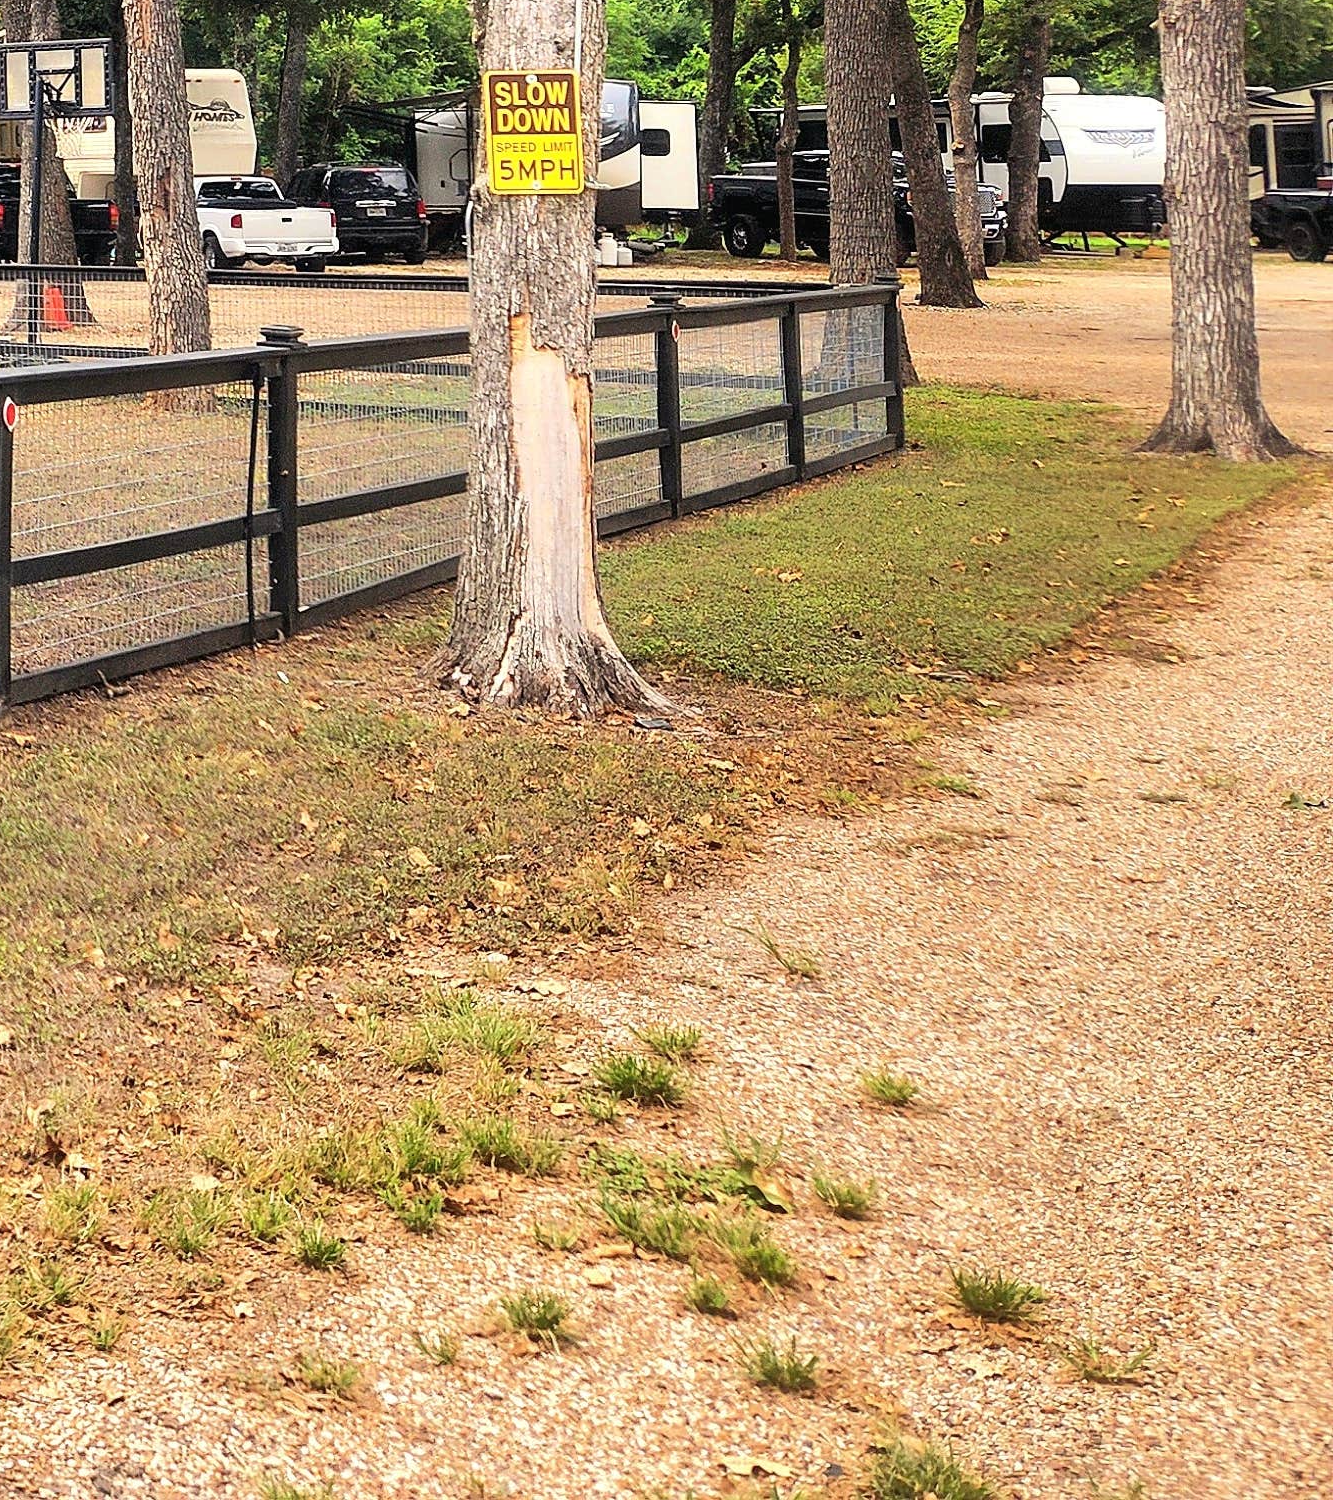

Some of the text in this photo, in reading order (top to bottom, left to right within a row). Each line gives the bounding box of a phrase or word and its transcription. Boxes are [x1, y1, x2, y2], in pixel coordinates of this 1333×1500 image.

[494, 81, 569, 107] SLOW
[193, 112, 235, 122] HOMES
[496, 107, 571, 133] DOWN
[495, 141, 573, 153] SPEED LIMIT
